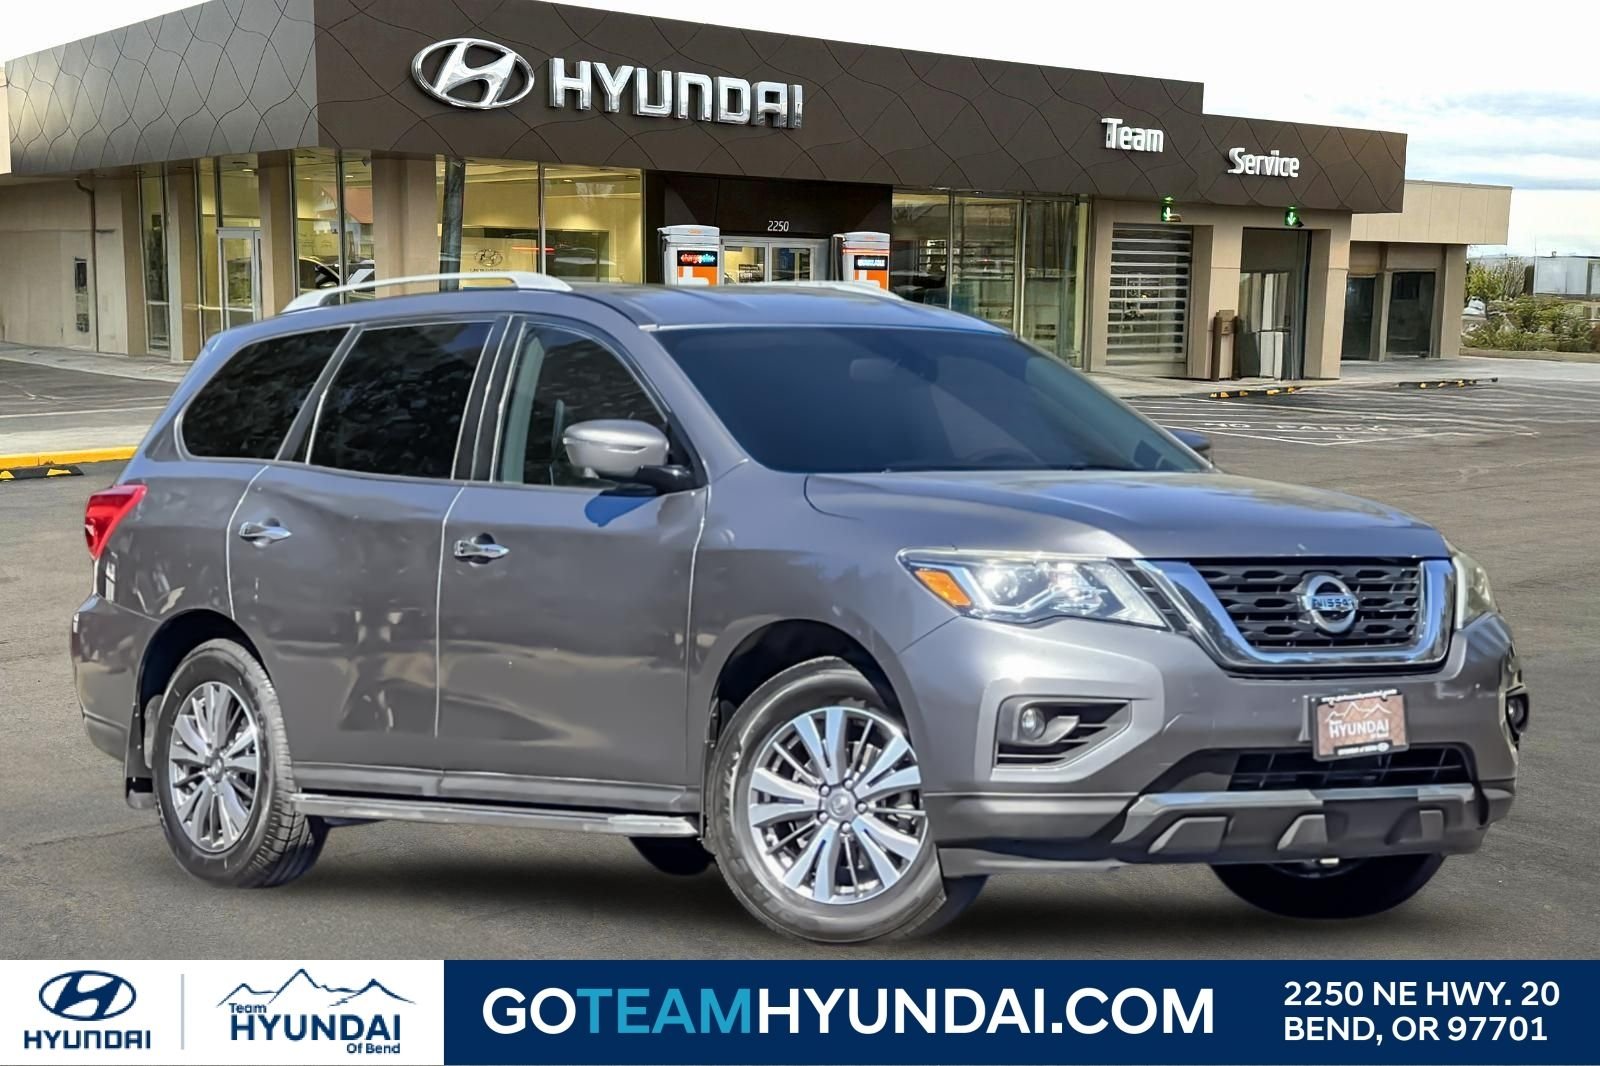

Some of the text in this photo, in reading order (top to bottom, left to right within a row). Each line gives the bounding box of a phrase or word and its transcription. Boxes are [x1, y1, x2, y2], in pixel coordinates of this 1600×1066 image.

[549, 57, 803, 129] HYUNDAI
[1101, 117, 1164, 153] Team
[1227, 147, 1300, 178] Service
[767, 220, 790, 232] 2250
[1329, 719, 1389, 739] HYUNDAI
